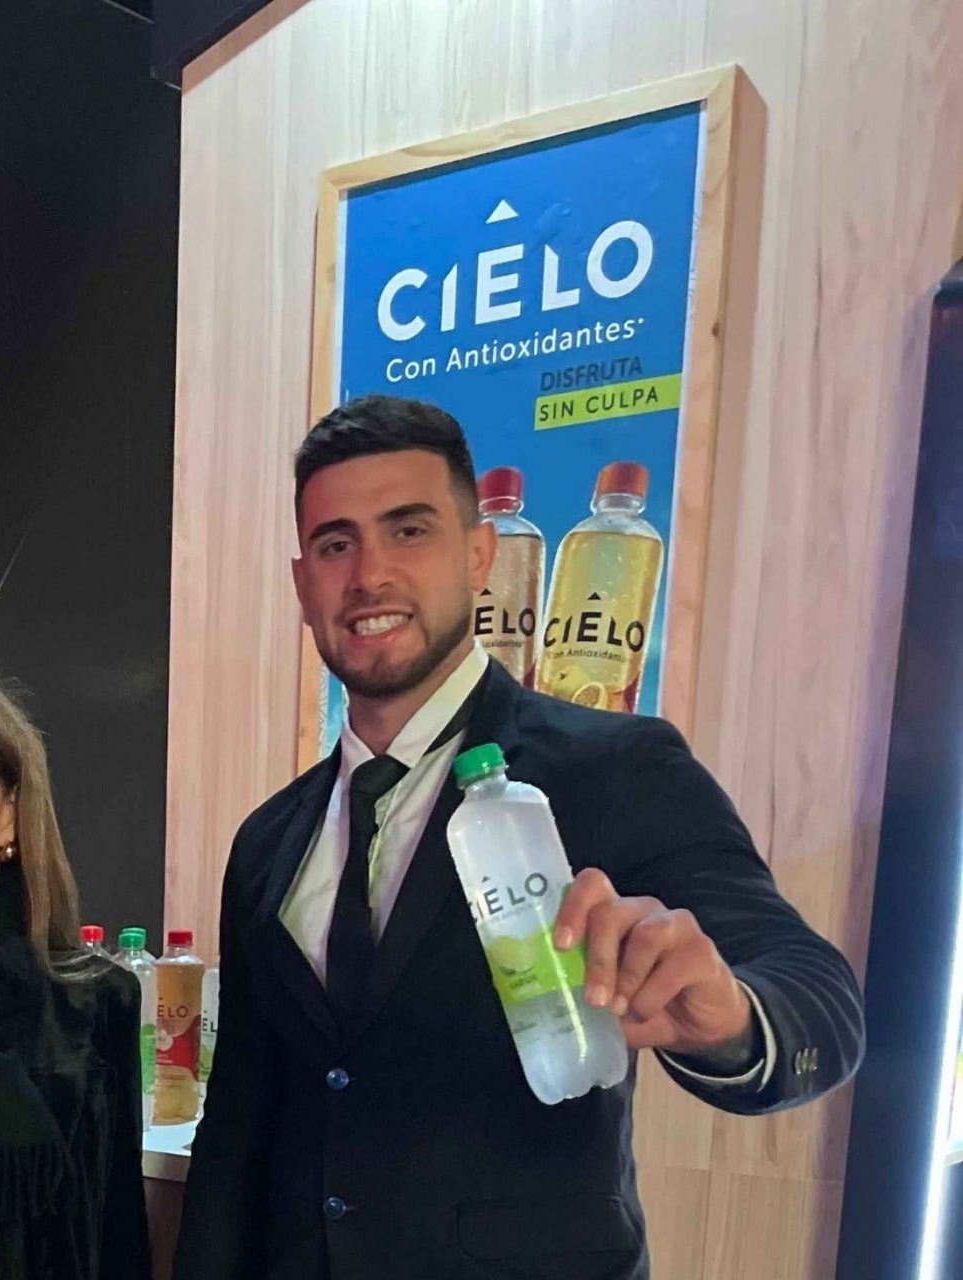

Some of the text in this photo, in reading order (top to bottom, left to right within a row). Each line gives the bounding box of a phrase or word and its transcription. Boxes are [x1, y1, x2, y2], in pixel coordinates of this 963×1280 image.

[387, 358, 436, 383] Con
[540, 356, 643, 392] DISFRUTA
[539, 387, 658, 422] SIN CULPA
